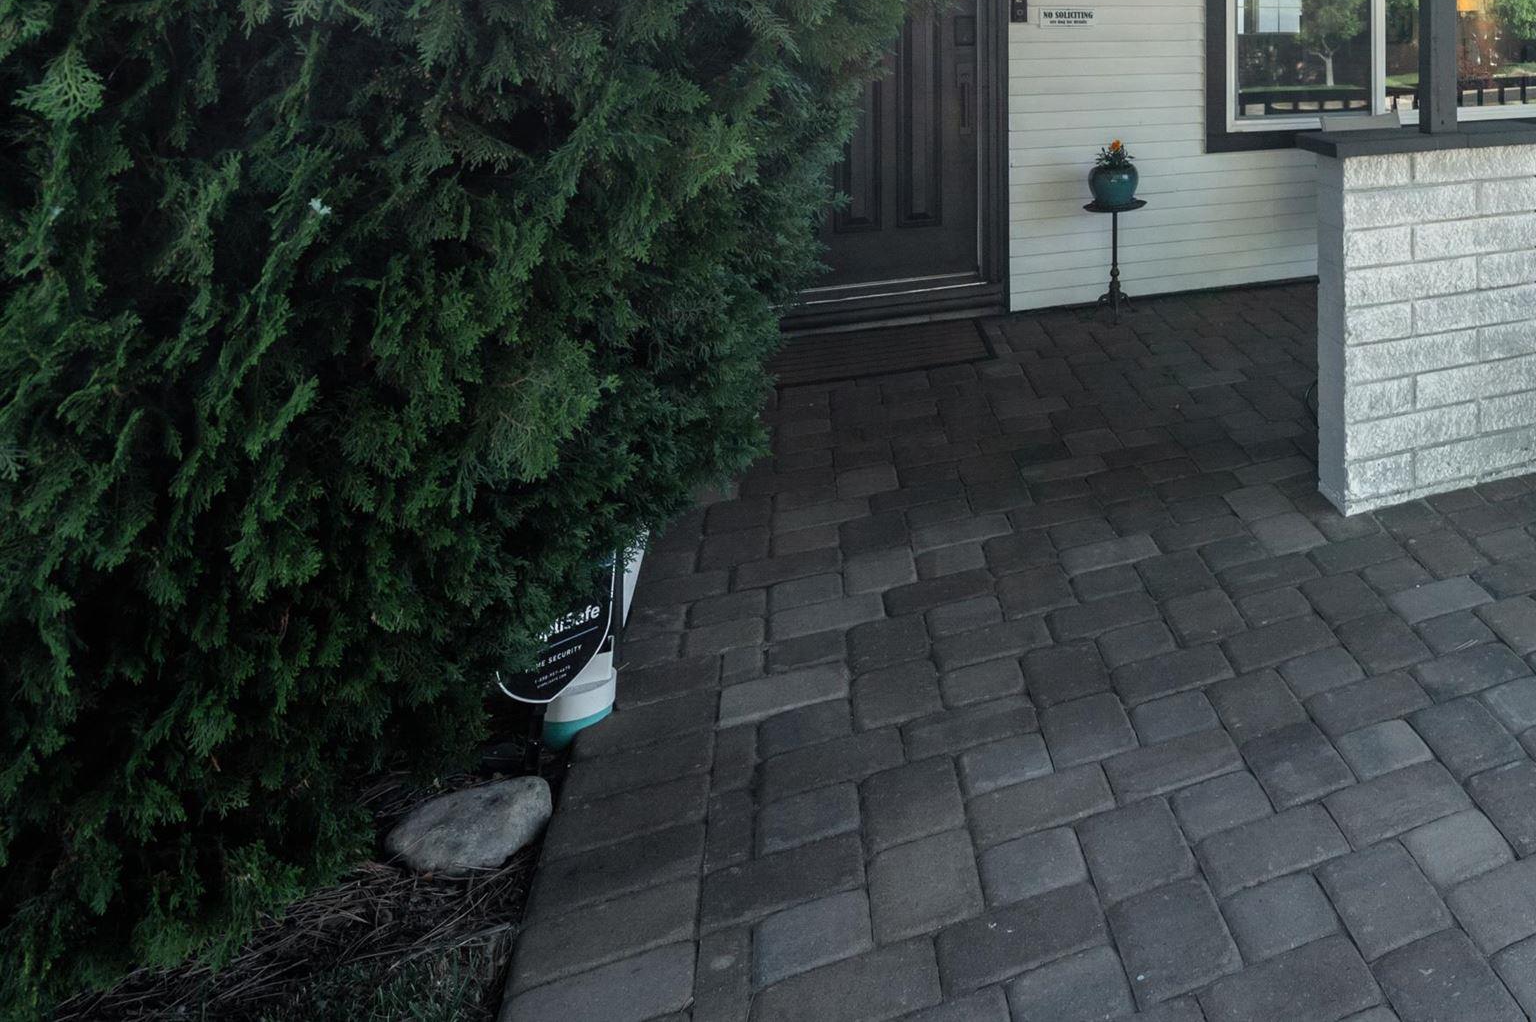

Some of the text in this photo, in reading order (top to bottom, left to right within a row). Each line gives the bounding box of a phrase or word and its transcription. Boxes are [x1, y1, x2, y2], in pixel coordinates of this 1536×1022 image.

[1043, 11, 1093, 19] NO SOLICITING
[548, 644, 582, 664] SECURITY
